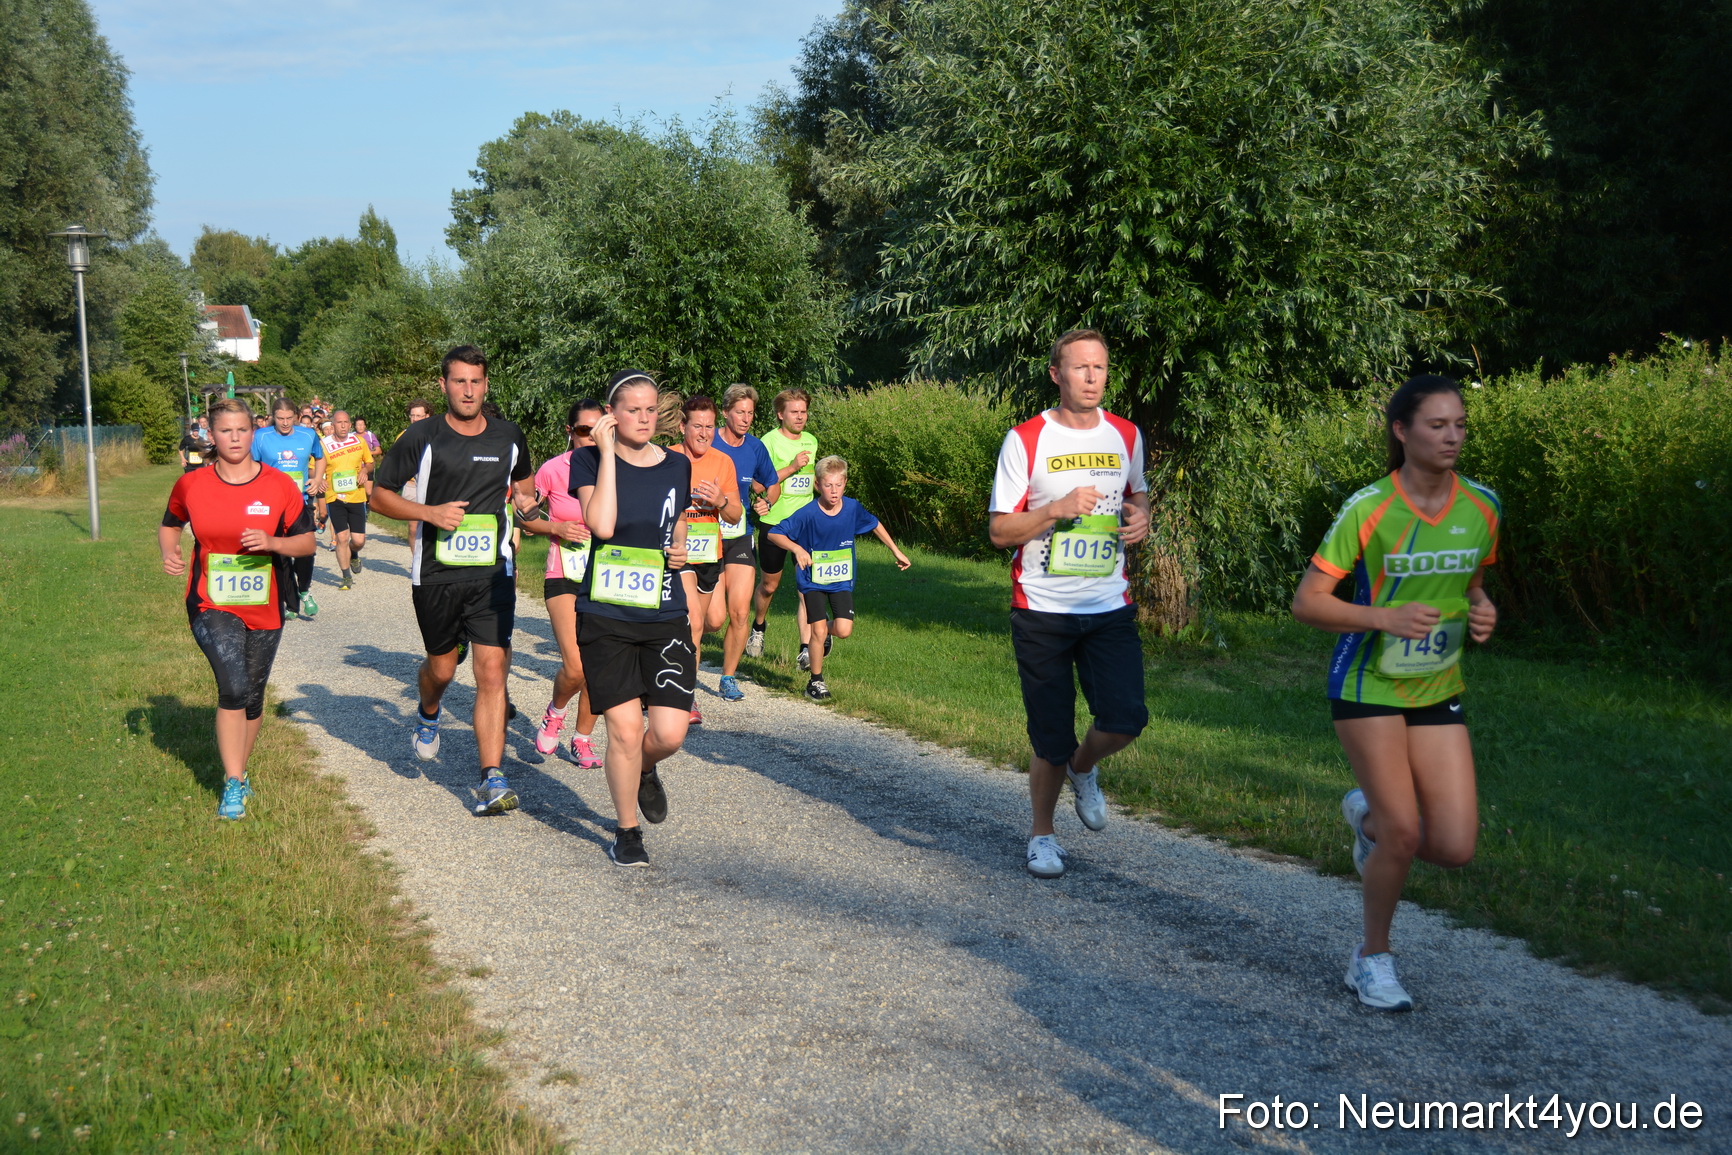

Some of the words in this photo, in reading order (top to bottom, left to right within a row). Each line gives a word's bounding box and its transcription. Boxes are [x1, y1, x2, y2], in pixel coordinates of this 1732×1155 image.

[330, 451, 346, 460] MAX
[1051, 455, 1115, 470] ONLINE
[1090, 470, 1121, 478] Germany
[337, 479, 353, 487] 884
[791, 477, 810, 488] 259
[444, 535, 491, 552] 1093
[1061, 538, 1113, 560] 1015
[1384, 548, 1479, 577] BOCK
[817, 563, 849, 578] 1498
[215, 575, 264, 591] 1168
[601, 568, 655, 592] 1136
[1400, 630, 1448, 657] 149
